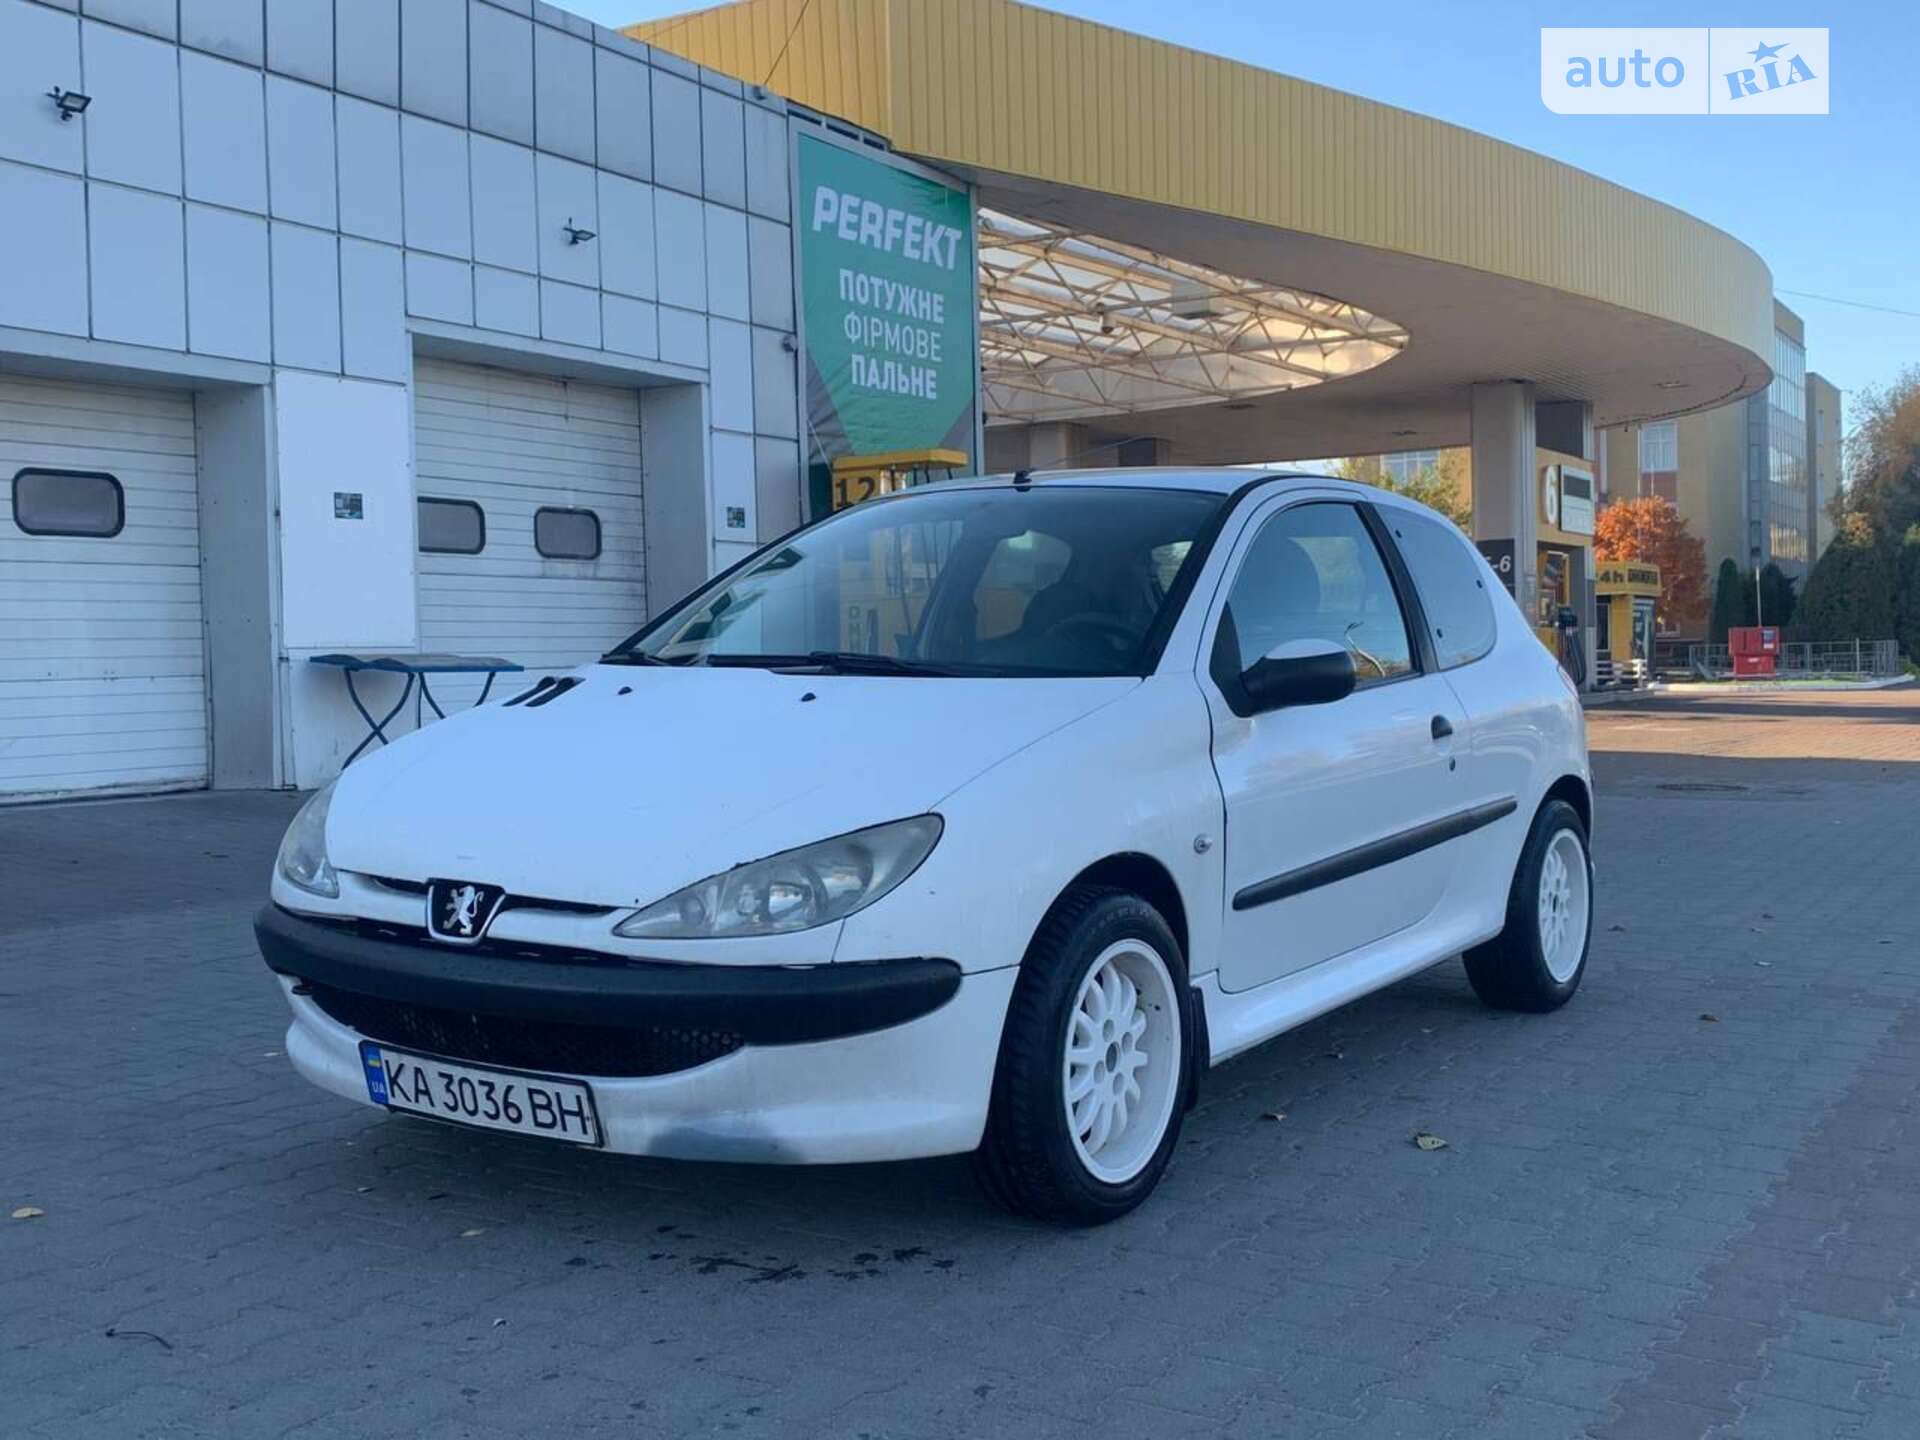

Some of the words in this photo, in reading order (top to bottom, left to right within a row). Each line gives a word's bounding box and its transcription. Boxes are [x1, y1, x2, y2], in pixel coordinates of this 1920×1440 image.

[812, 186, 962, 271] PERFEKT
[839, 268, 945, 324] ПОТУЖНЕ
[844, 311, 942, 362] ФІРМОВЕ
[851, 353, 938, 400] ПАЛЬНЕ
[835, 477, 876, 508] 12
[1545, 465, 1558, 524] 6
[371, 1080, 385, 1094] UA
[384, 1060, 435, 1108] KA
[438, 1072, 523, 1125] 3036
[527, 1088, 589, 1136] BH
